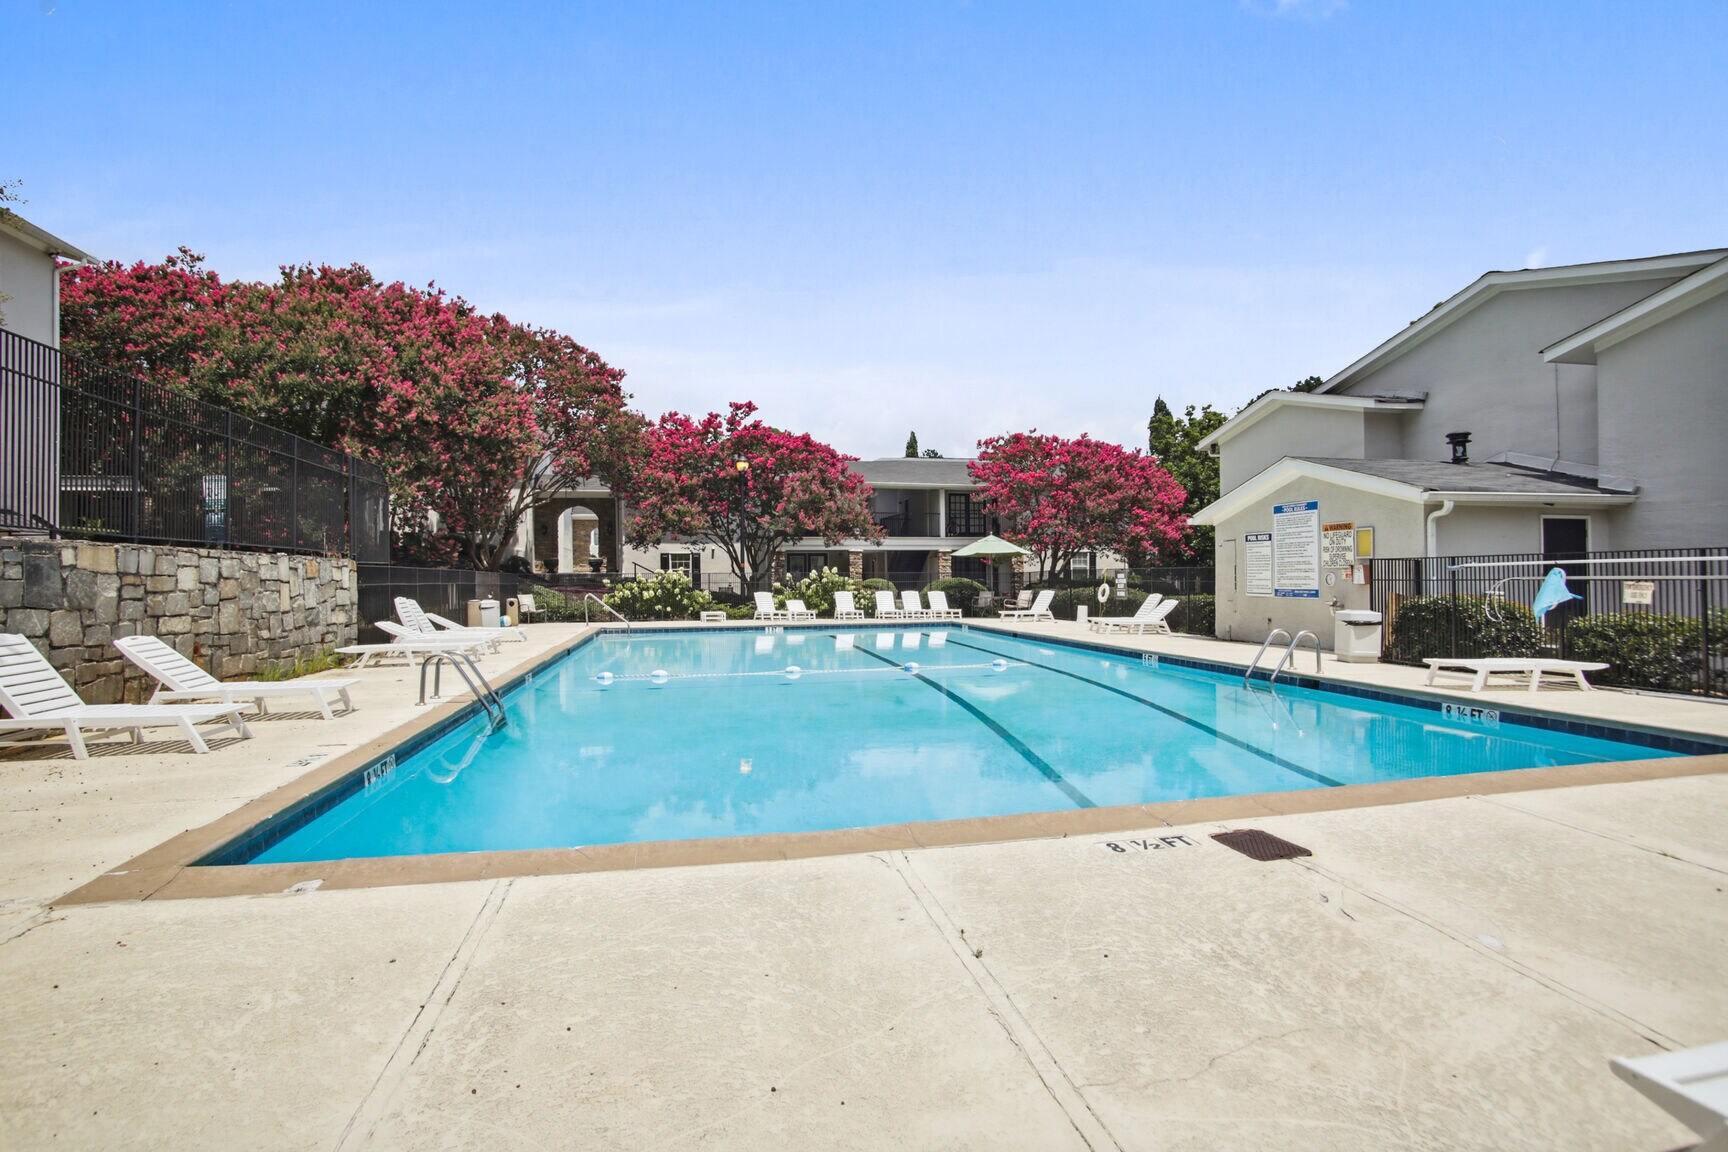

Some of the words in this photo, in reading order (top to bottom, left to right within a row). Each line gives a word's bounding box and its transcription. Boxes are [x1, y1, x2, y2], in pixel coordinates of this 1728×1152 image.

[1329, 522, 1352, 531] WARNING
[1247, 534, 1257, 542] POOL
[1330, 530, 1353, 538] LIFEGUARD
[1336, 537, 1346, 545] DUTY
[1470, 708, 1484, 719] FT
[1106, 842, 1127, 853] 8
[1159, 835, 1193, 848] FT
